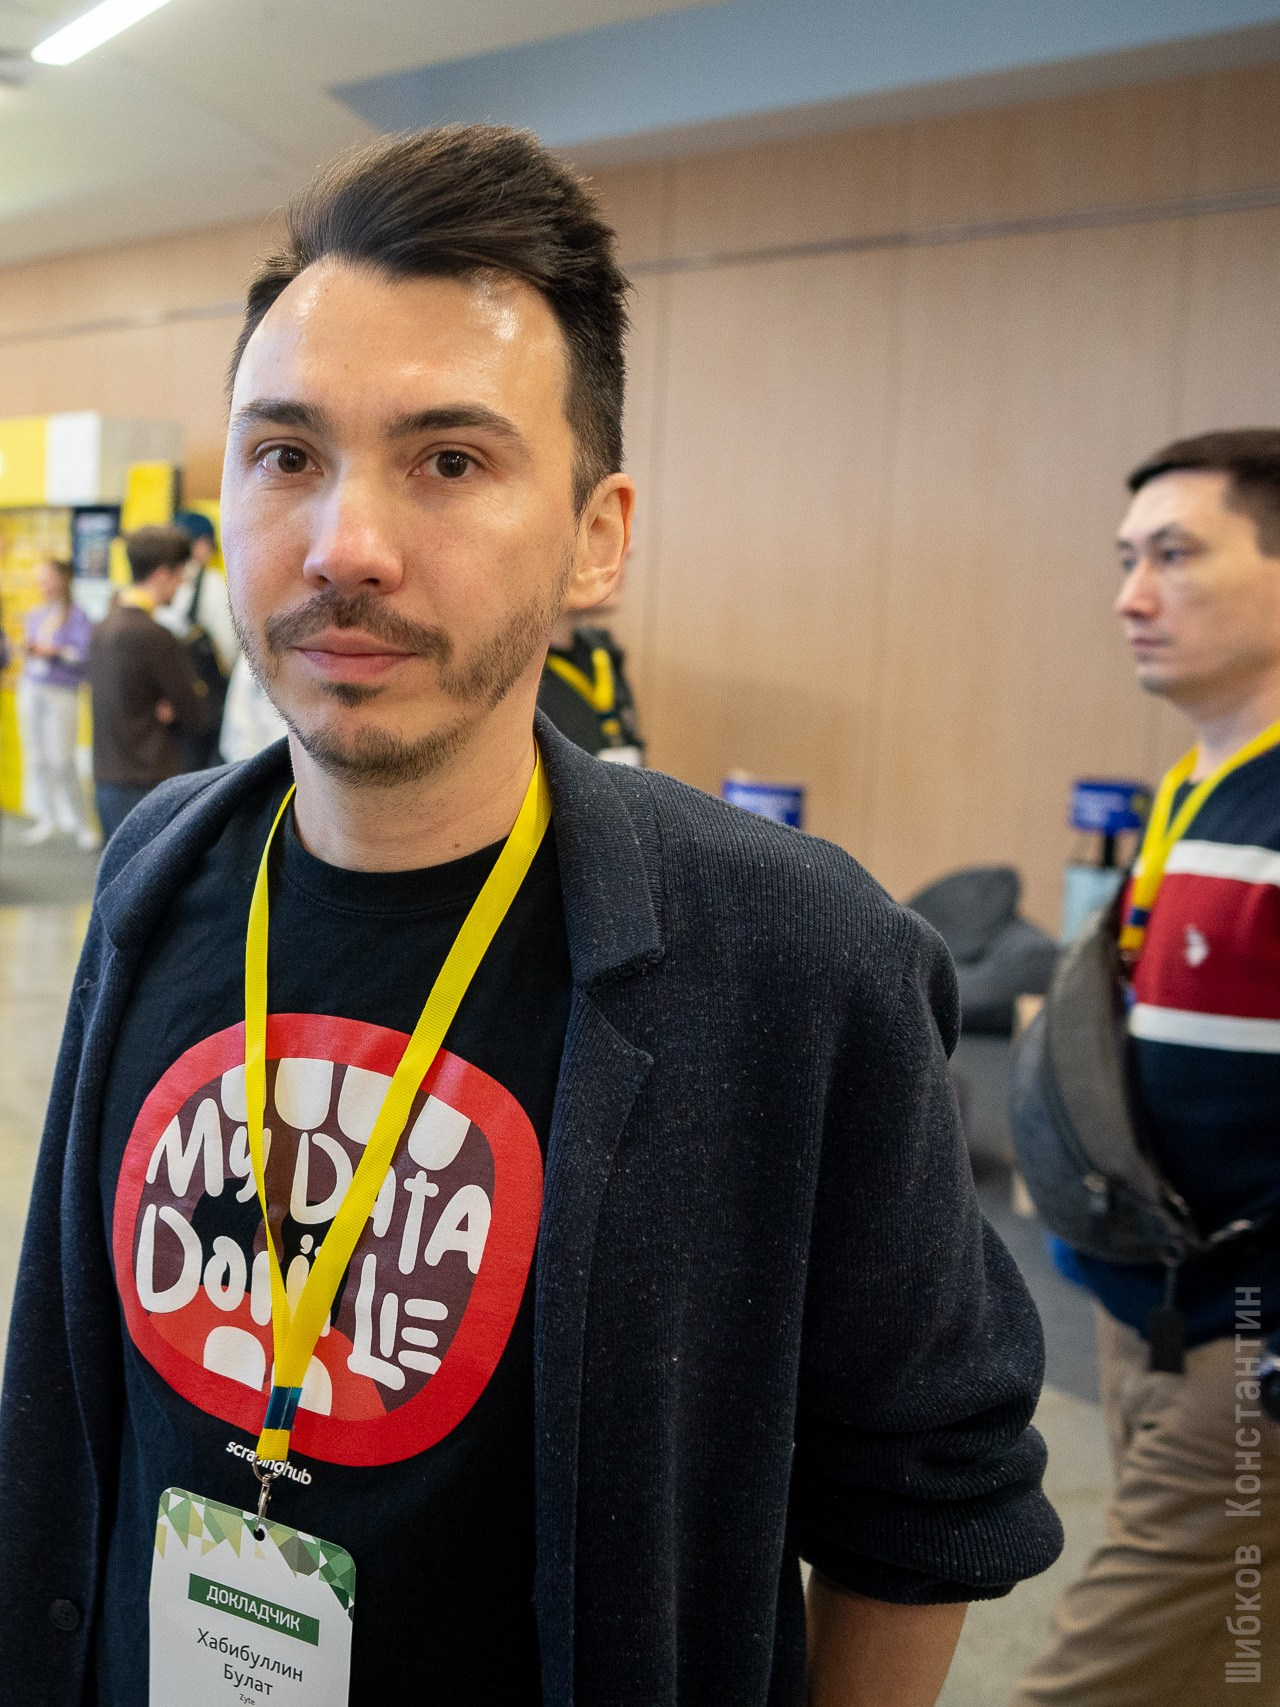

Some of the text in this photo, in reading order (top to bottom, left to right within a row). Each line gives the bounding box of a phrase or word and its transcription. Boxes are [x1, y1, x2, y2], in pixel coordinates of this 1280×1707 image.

[146, 1098, 271, 1203] My
[136, 1204, 449, 1391] Don' LIE
[206, 1585, 300, 1631] ДОКЛАДЧИК
[197, 1627, 303, 1682] Хабибуллин
[224, 1663, 273, 1695] Булат
